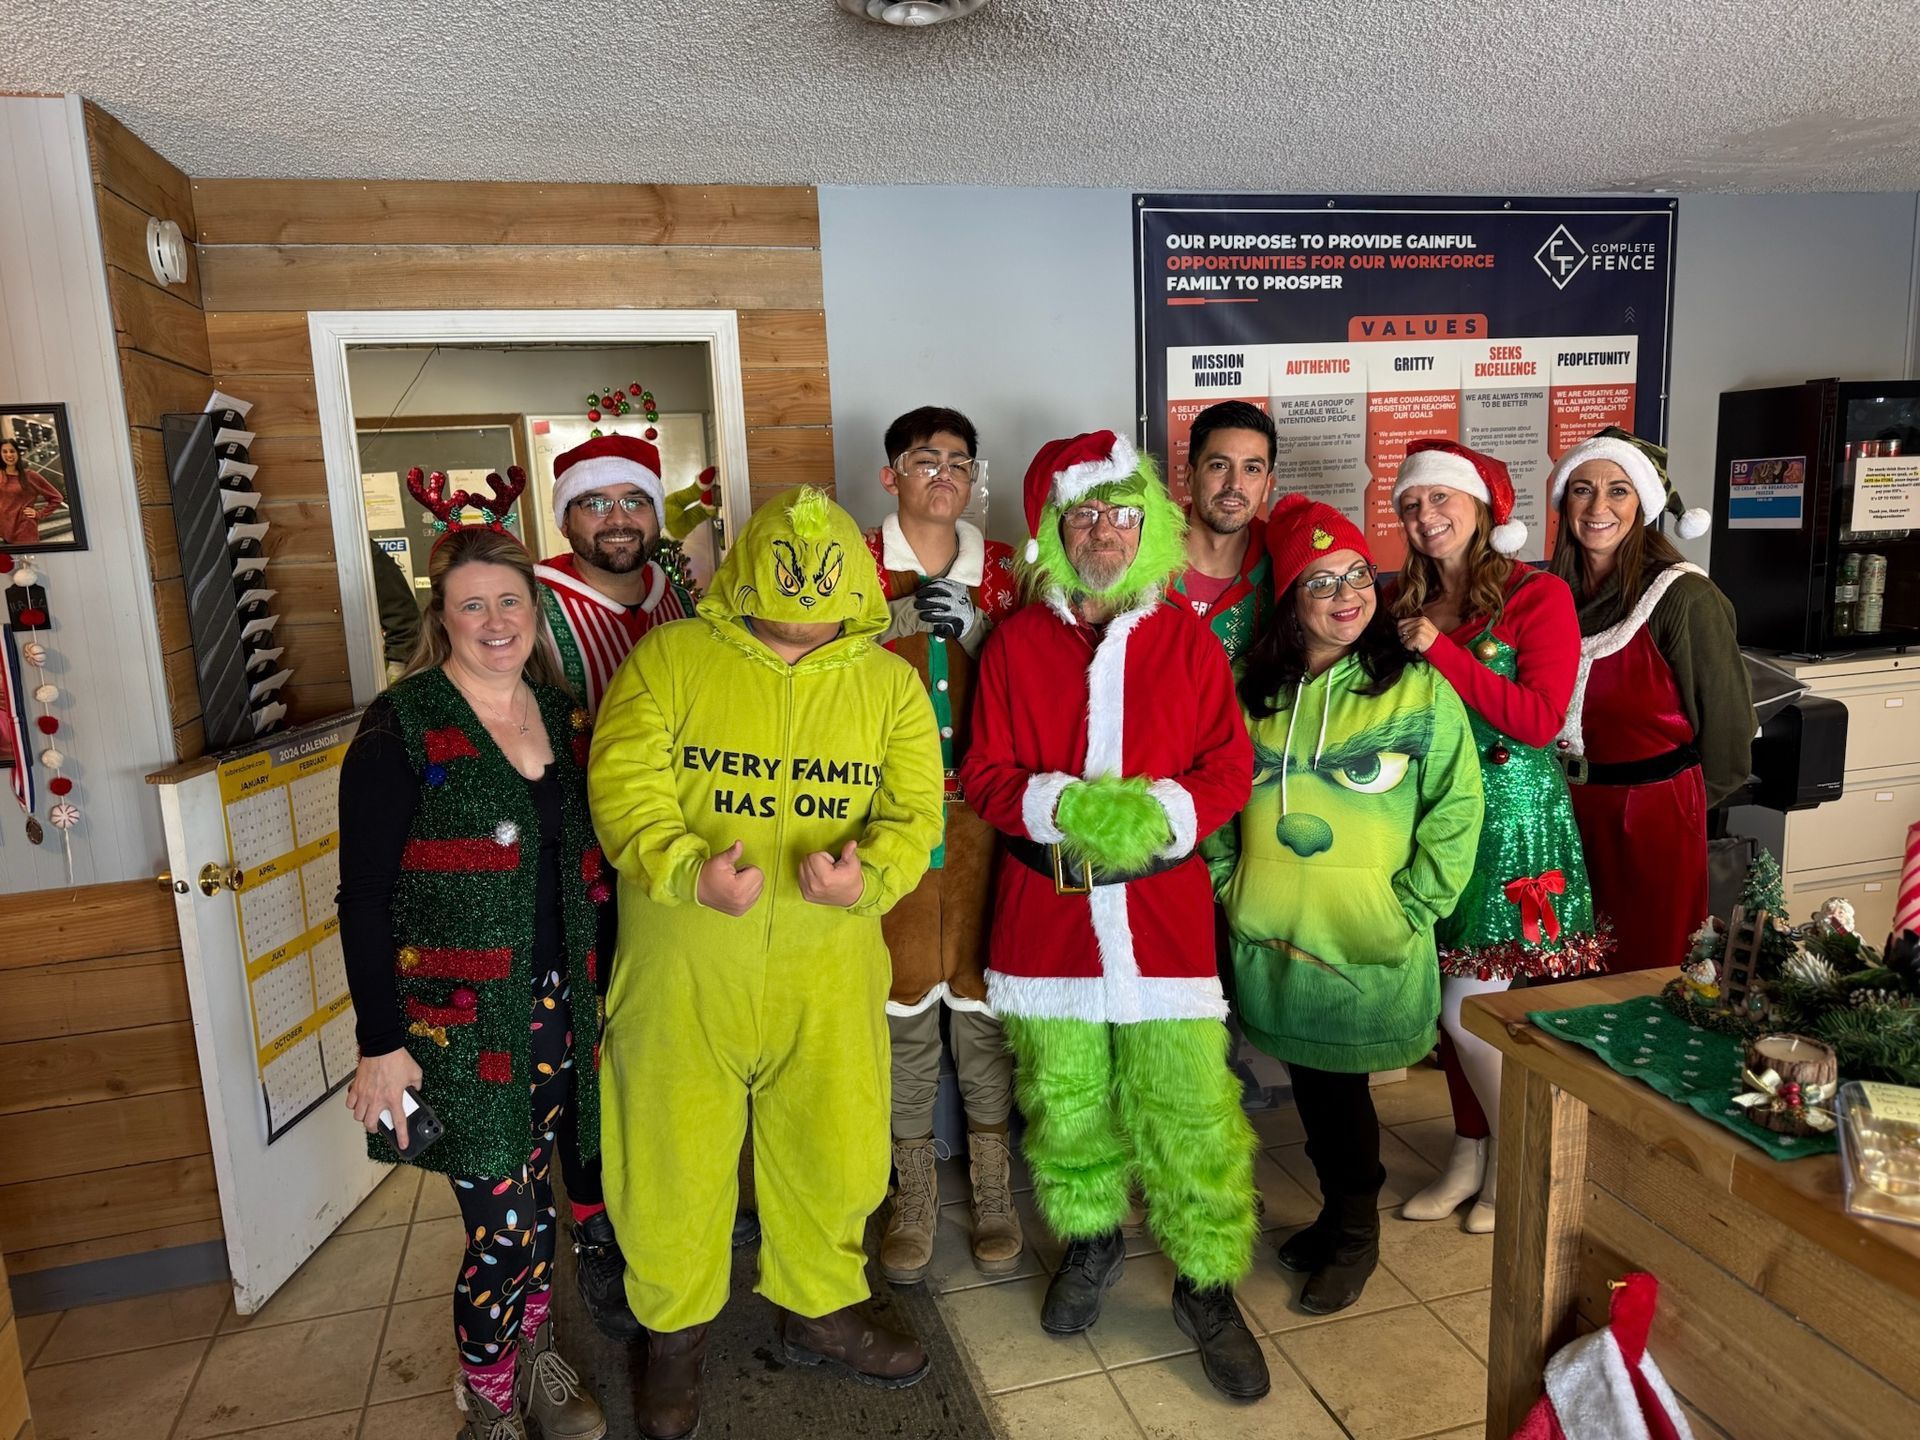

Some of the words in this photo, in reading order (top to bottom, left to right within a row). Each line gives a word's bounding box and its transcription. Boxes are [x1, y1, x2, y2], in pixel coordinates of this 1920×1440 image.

[1166, 234, 1205, 249] OUR
[1209, 234, 1297, 249] PURPOSE:
[1300, 234, 1324, 249] TO
[1328, 234, 1403, 249] PROVIDE
[1406, 234, 1477, 249] GAINFUL
[1592, 243, 1655, 253] COMPLETE
[1166, 255, 1306, 270] OPPORTUNITIES
[1311, 255, 1345, 269] FOR
[1350, 254, 1385, 269] OUR
[1389, 254, 1495, 268] WORKFORCE
[1592, 255, 1655, 271] FENCE
[1166, 276, 1231, 291] FAMILY
[1235, 276, 1259, 290] TO
[1263, 275, 1343, 290] PROSPER
[1361, 319, 1477, 337] VALUES
[1489, 346, 1522, 360] SEEKS
[1557, 351, 1630, 366] PEOPLETUNITY
[1192, 353, 1244, 370] MISSION
[1286, 358, 1351, 375] AUTHENTIC
[1394, 356, 1434, 371] GRITTY
[1474, 361, 1536, 377] EXCELLENCE
[1194, 371, 1242, 387] MINDED
[1400, 395, 1455, 403] COURAGEOUSLY
[1288, 408, 1323, 416] LIKEABLE
[1370, 404, 1411, 412] PERSISTENT
[1177, 413, 1187, 421] TO
[1734, 463, 1748, 474] 30
[378, 541, 405, 551] TICE
[278, 746, 299, 761] 2024
[300, 733, 339, 754] CALENDAR
[299, 754, 328, 771] FEBRUARY
[683, 746, 782, 780] EVERY
[791, 758, 881, 787] FAMILY
[240, 774, 269, 791] JANUARY
[714, 790, 776, 818] HAS
[794, 794, 850, 819] ONE
[319, 838, 330, 848] MAY
[258, 863, 277, 877] APRIL
[271, 948, 286, 962] JULY
[274, 1026, 303, 1050] OCTOBER
